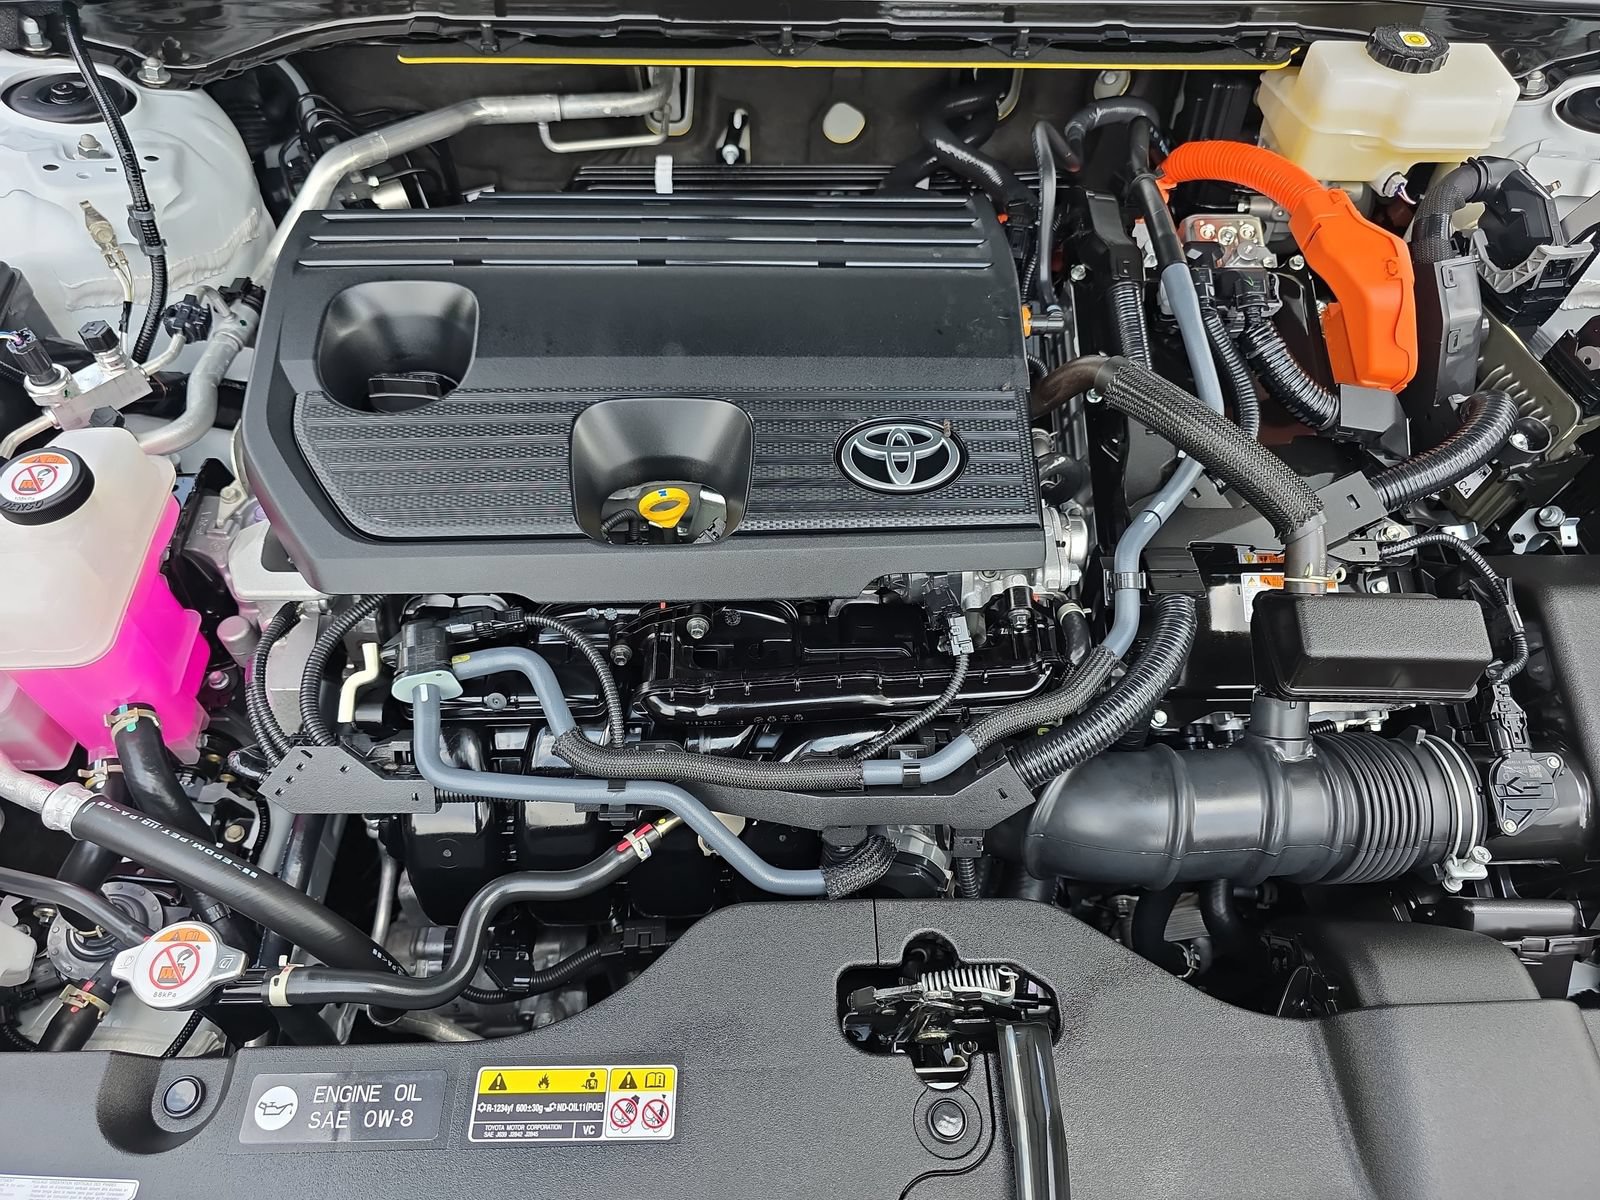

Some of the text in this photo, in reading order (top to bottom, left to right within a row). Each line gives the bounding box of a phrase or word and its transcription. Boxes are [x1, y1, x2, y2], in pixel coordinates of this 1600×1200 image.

[1459, 481, 1471, 495] C4
[1, 500, 45, 512] DENSO
[313, 1083, 423, 1103] ENGINE OIL
[486, 1103, 513, 1114] R-1234yf
[308, 1109, 414, 1129] SAE 0W-8
[526, 1123, 563, 1131] CORPORATION
[583, 1125, 596, 1135] VC
